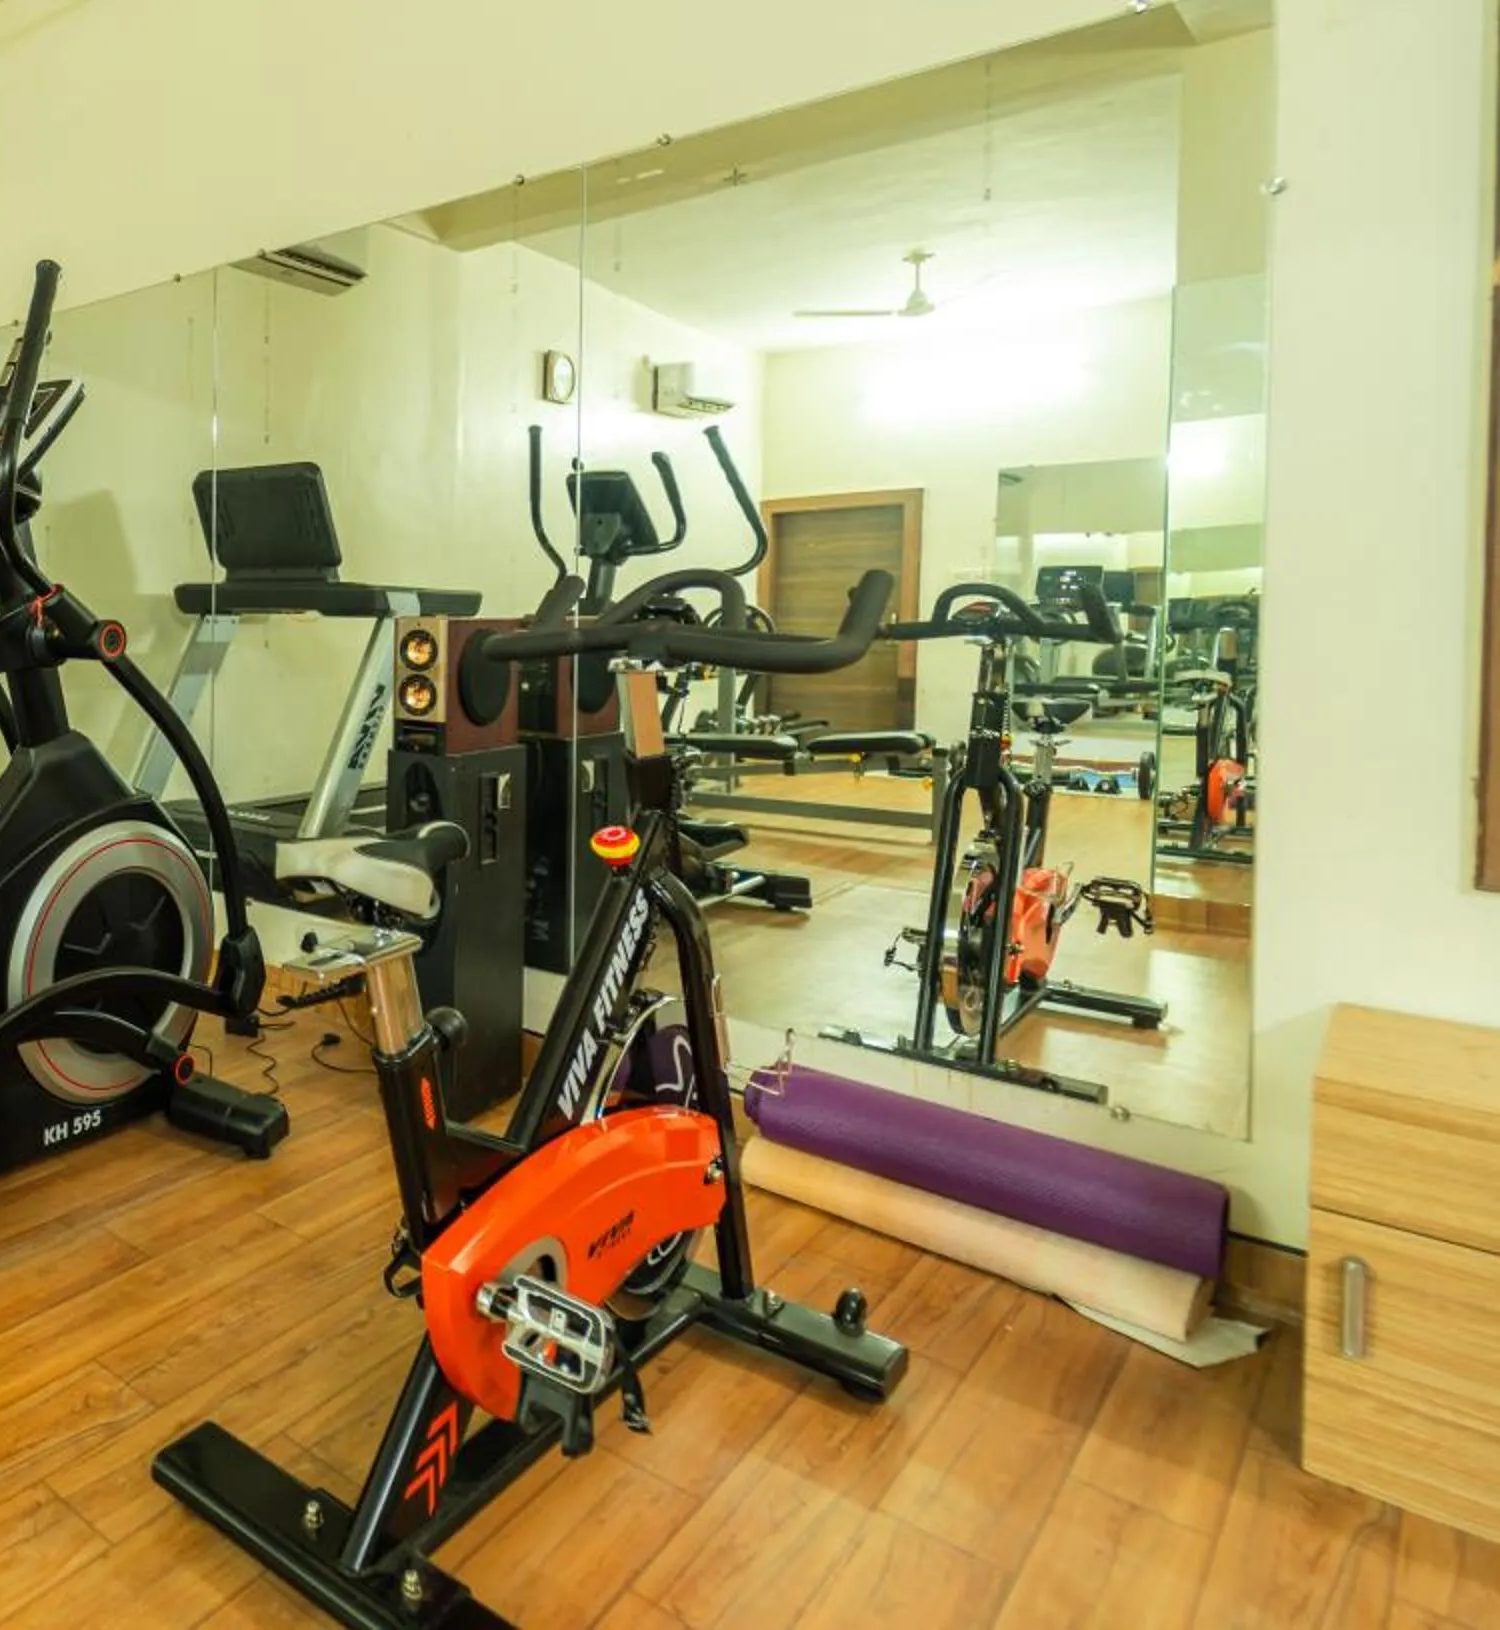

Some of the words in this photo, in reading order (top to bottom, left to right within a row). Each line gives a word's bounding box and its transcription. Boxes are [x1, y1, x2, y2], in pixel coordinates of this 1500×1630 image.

[557, 1027, 598, 1121] VIVA
[593, 887, 649, 1035] FITNESS
[43, 1120, 69, 1146] KH
[72, 1109, 102, 1136] 595
